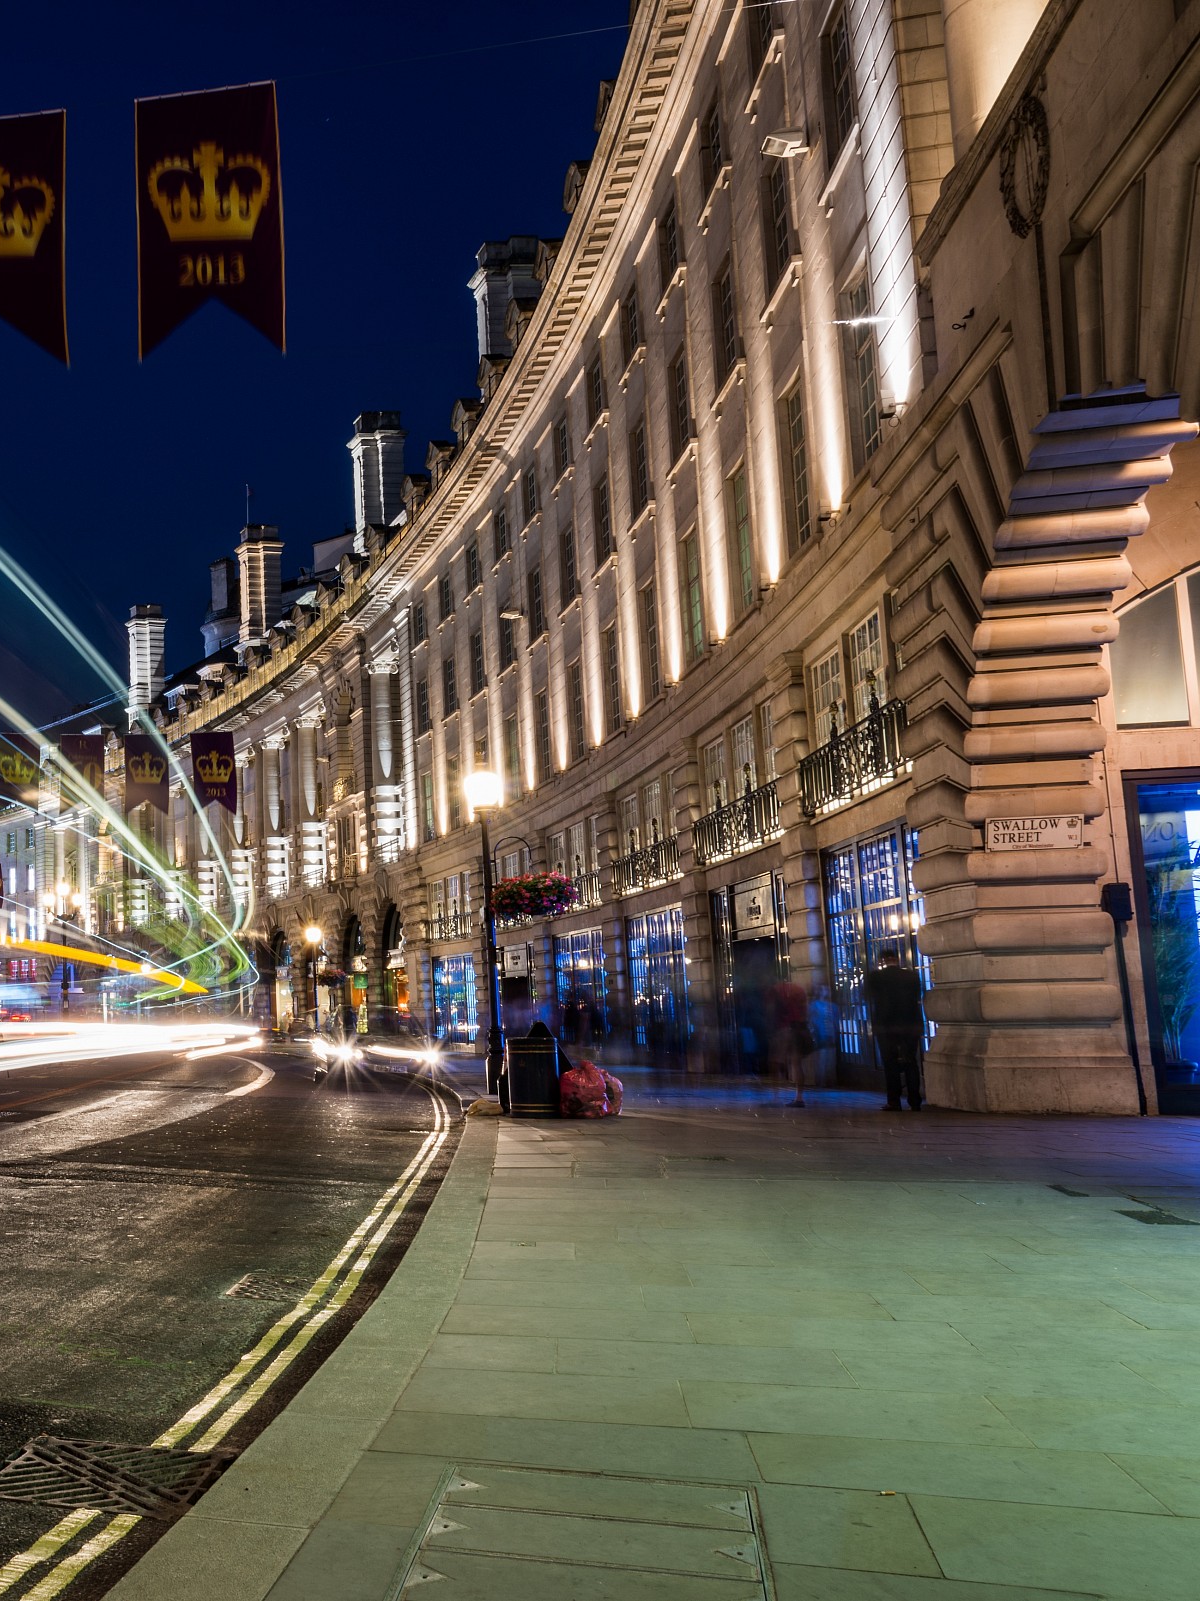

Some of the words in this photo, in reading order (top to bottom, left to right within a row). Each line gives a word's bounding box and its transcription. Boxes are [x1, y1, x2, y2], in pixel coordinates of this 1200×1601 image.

[179, 253, 246, 286] 2013
[205, 787, 227, 797] 2013
[993, 819, 1061, 831] SWALLOW
[993, 832, 1042, 844] STREET
